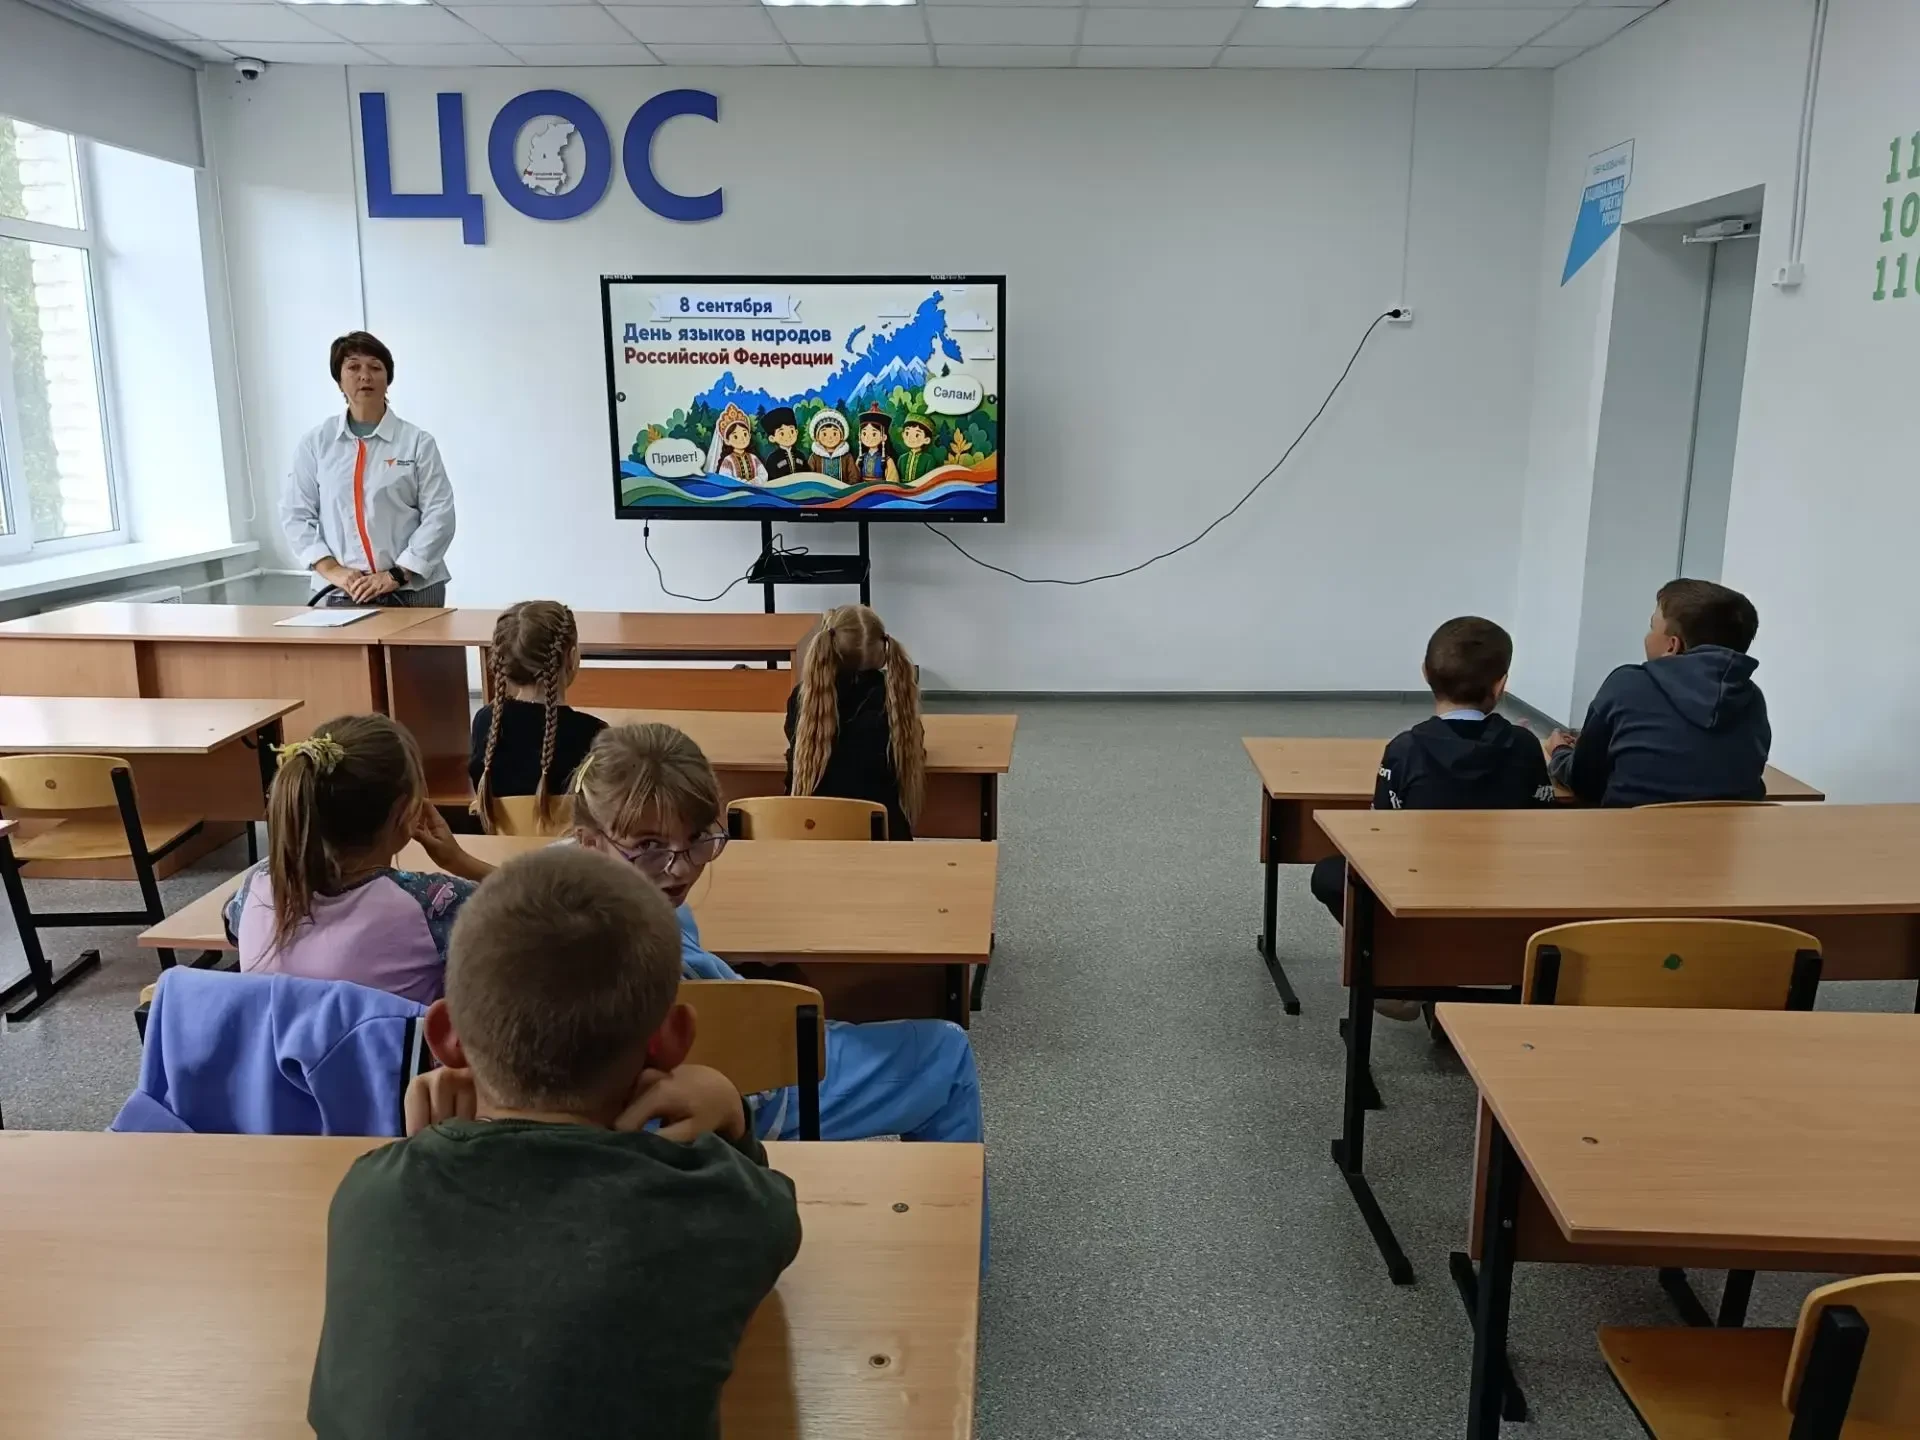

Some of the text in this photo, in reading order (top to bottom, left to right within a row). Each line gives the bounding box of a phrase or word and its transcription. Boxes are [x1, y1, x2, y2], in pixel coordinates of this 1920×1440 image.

[359, 88, 724, 246] ЦОС
[1880, 192, 1920, 243] 10
[1872, 253, 1920, 301] 11
[679, 296, 773, 316] 8 сентября
[623, 322, 832, 346] День языков народов
[624, 346, 834, 369] Российской Федерации
[651, 450, 698, 467] Привет!
